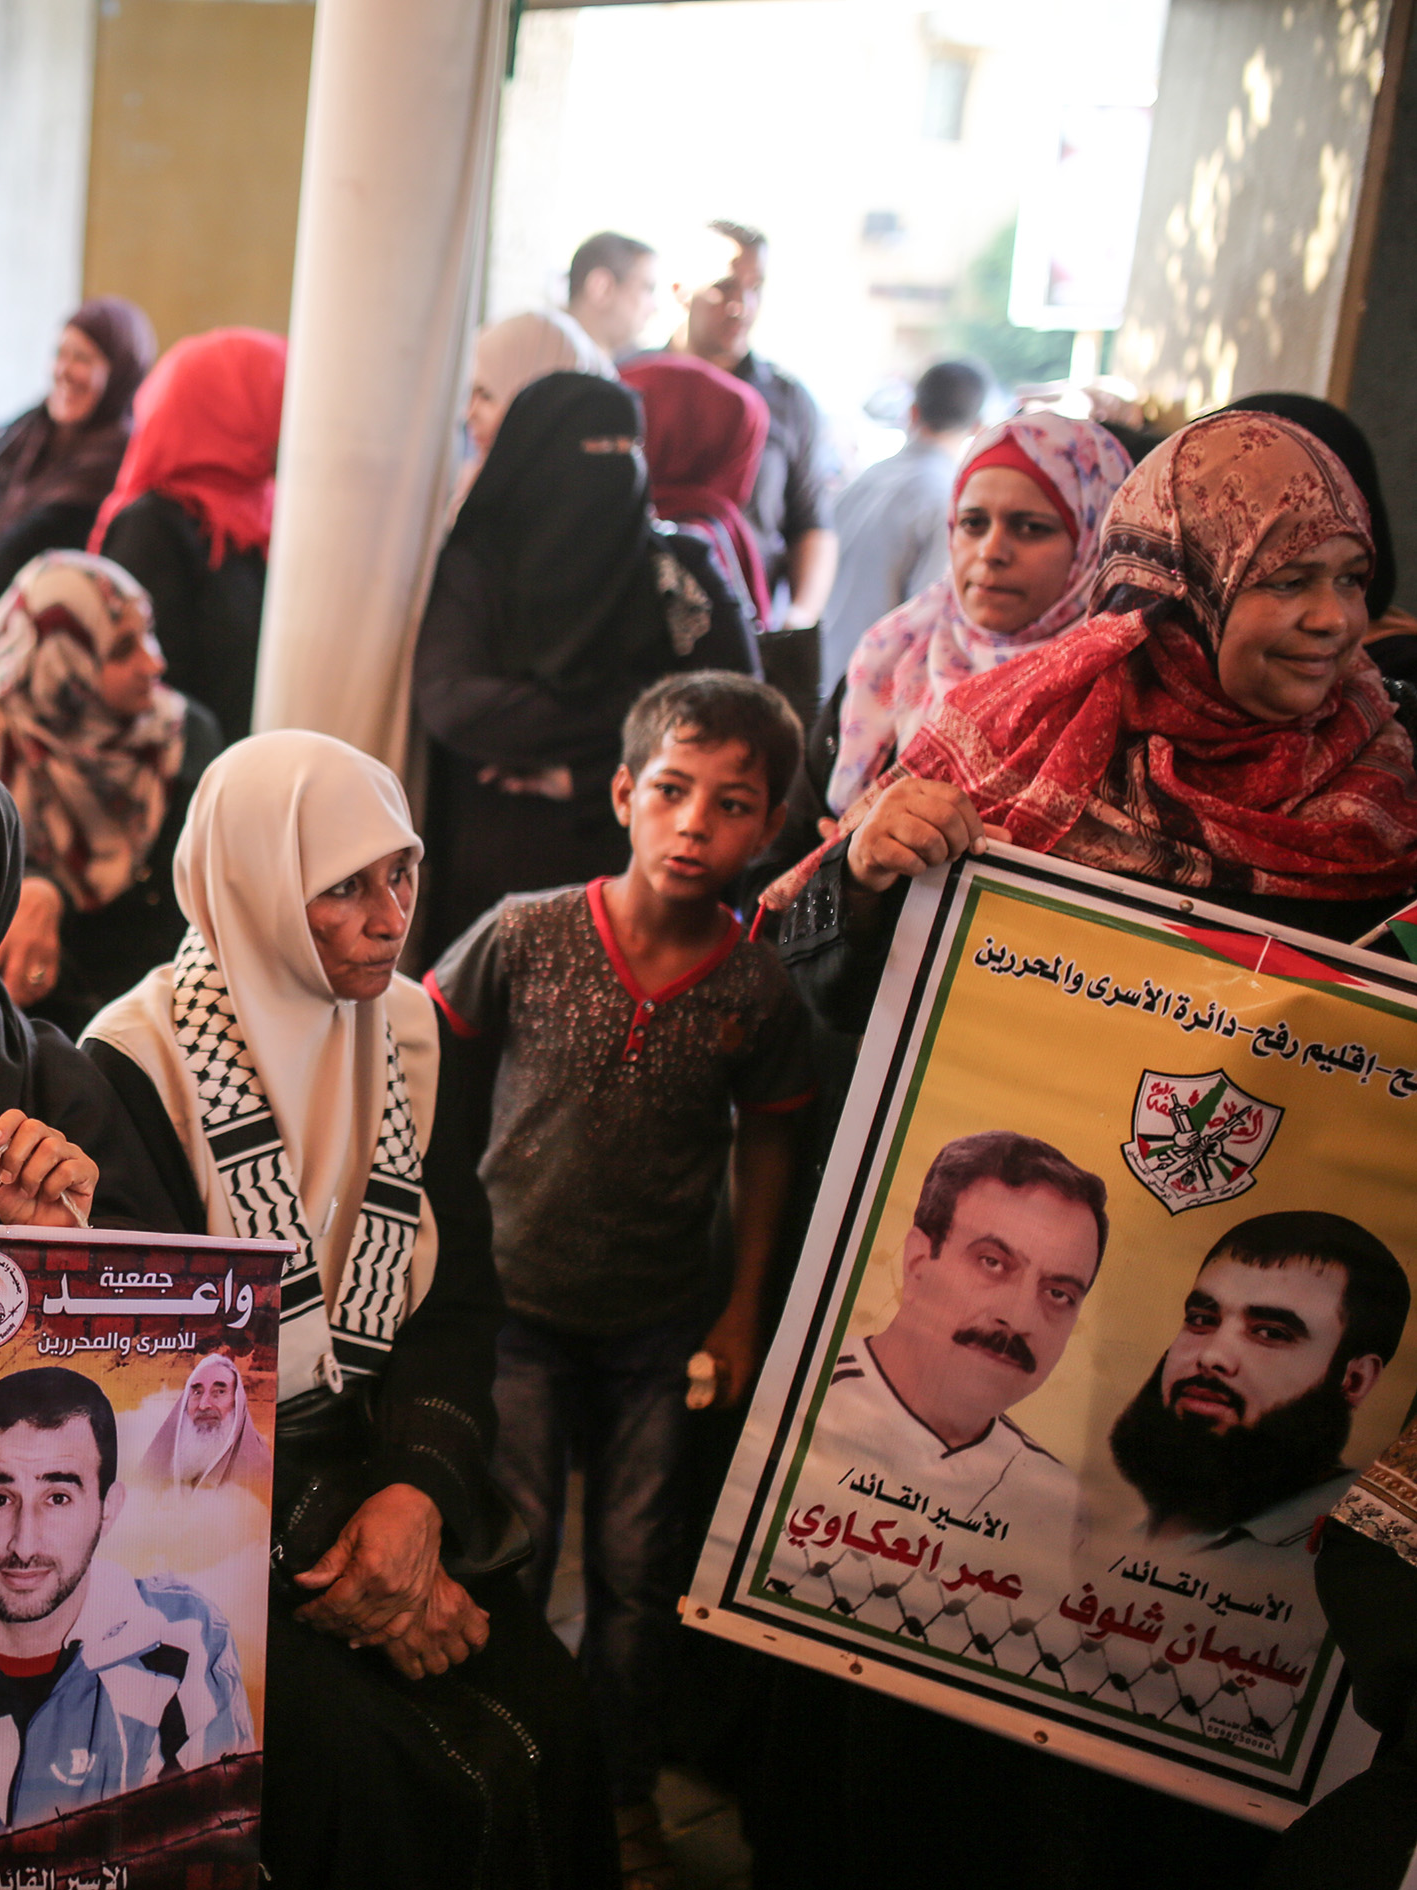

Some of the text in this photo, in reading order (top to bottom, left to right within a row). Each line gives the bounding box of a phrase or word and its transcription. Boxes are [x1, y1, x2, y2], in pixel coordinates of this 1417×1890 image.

[974, 937, 1084, 995] والمحررين
[1086, 979, 1172, 1016] الأسرى
[43, 1268, 253, 1329] واعد
[100, 1266, 173, 1294] جمعية
[38, 1328, 196, 1356] للأسرى والمحررين
[928, 1506, 1009, 1540] الأسير
[788, 1504, 1023, 1600] عمر العكاوي
[1206, 1591, 1293, 1623] الأسير
[1059, 1582, 1308, 1688] سليمان شلوف
